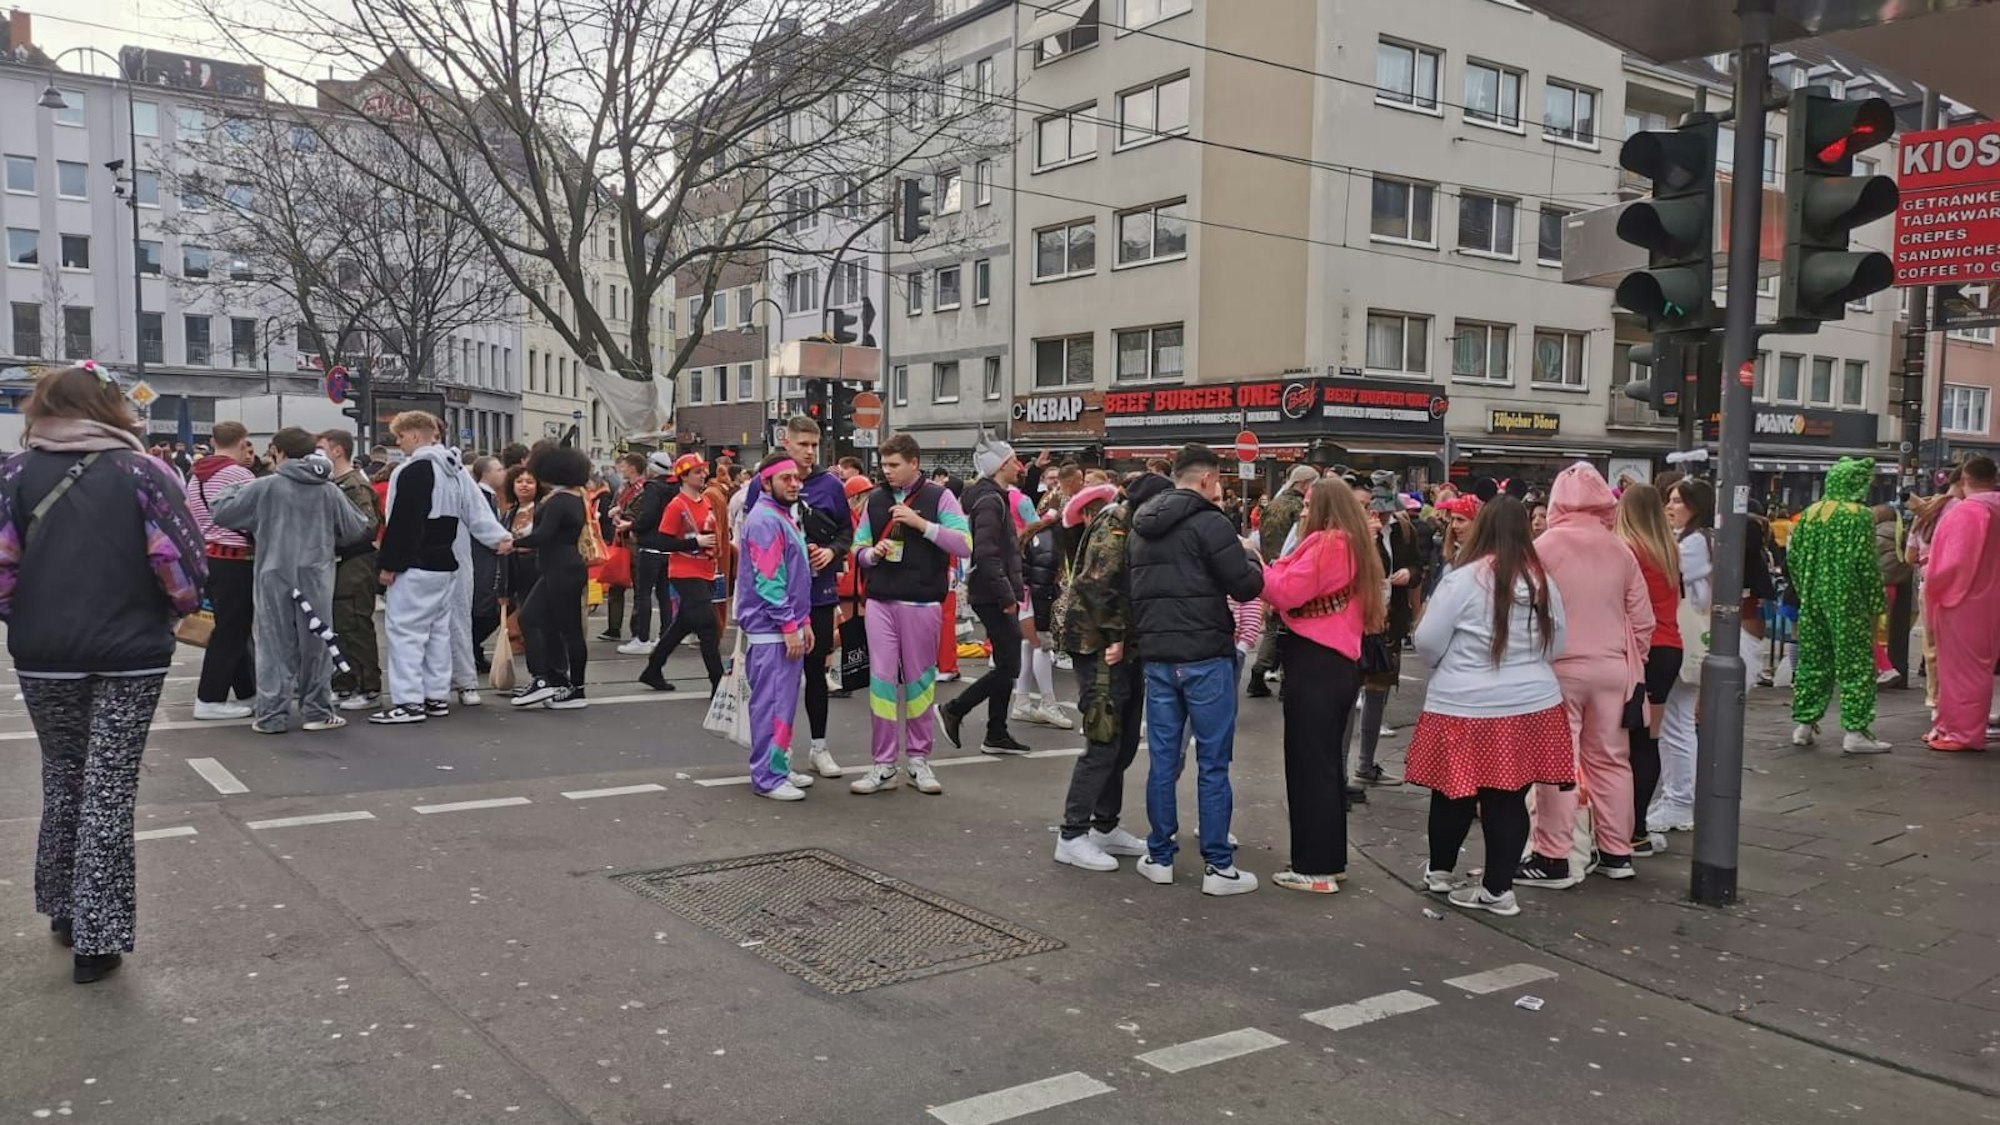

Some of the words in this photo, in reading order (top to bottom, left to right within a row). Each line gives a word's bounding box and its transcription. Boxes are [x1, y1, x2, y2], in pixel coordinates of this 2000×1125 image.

[1902, 133, 2000, 176] KIOS
[1901, 207, 2000, 227] TABAKWAR
[1900, 229, 1968, 245] CREPES
[1898, 264, 1959, 279] COFFEE
[1964, 262, 1985, 274] TO
[1104, 392, 1152, 414] BEEF
[1154, 387, 1232, 411] BURGER
[1237, 383, 1282, 407] ONE
[1323, 387, 1358, 404] BEEF
[1358, 390, 1405, 406] BURGER
[1405, 393, 1430, 408] ONE
[1026, 396, 1082, 422] KEBAP
